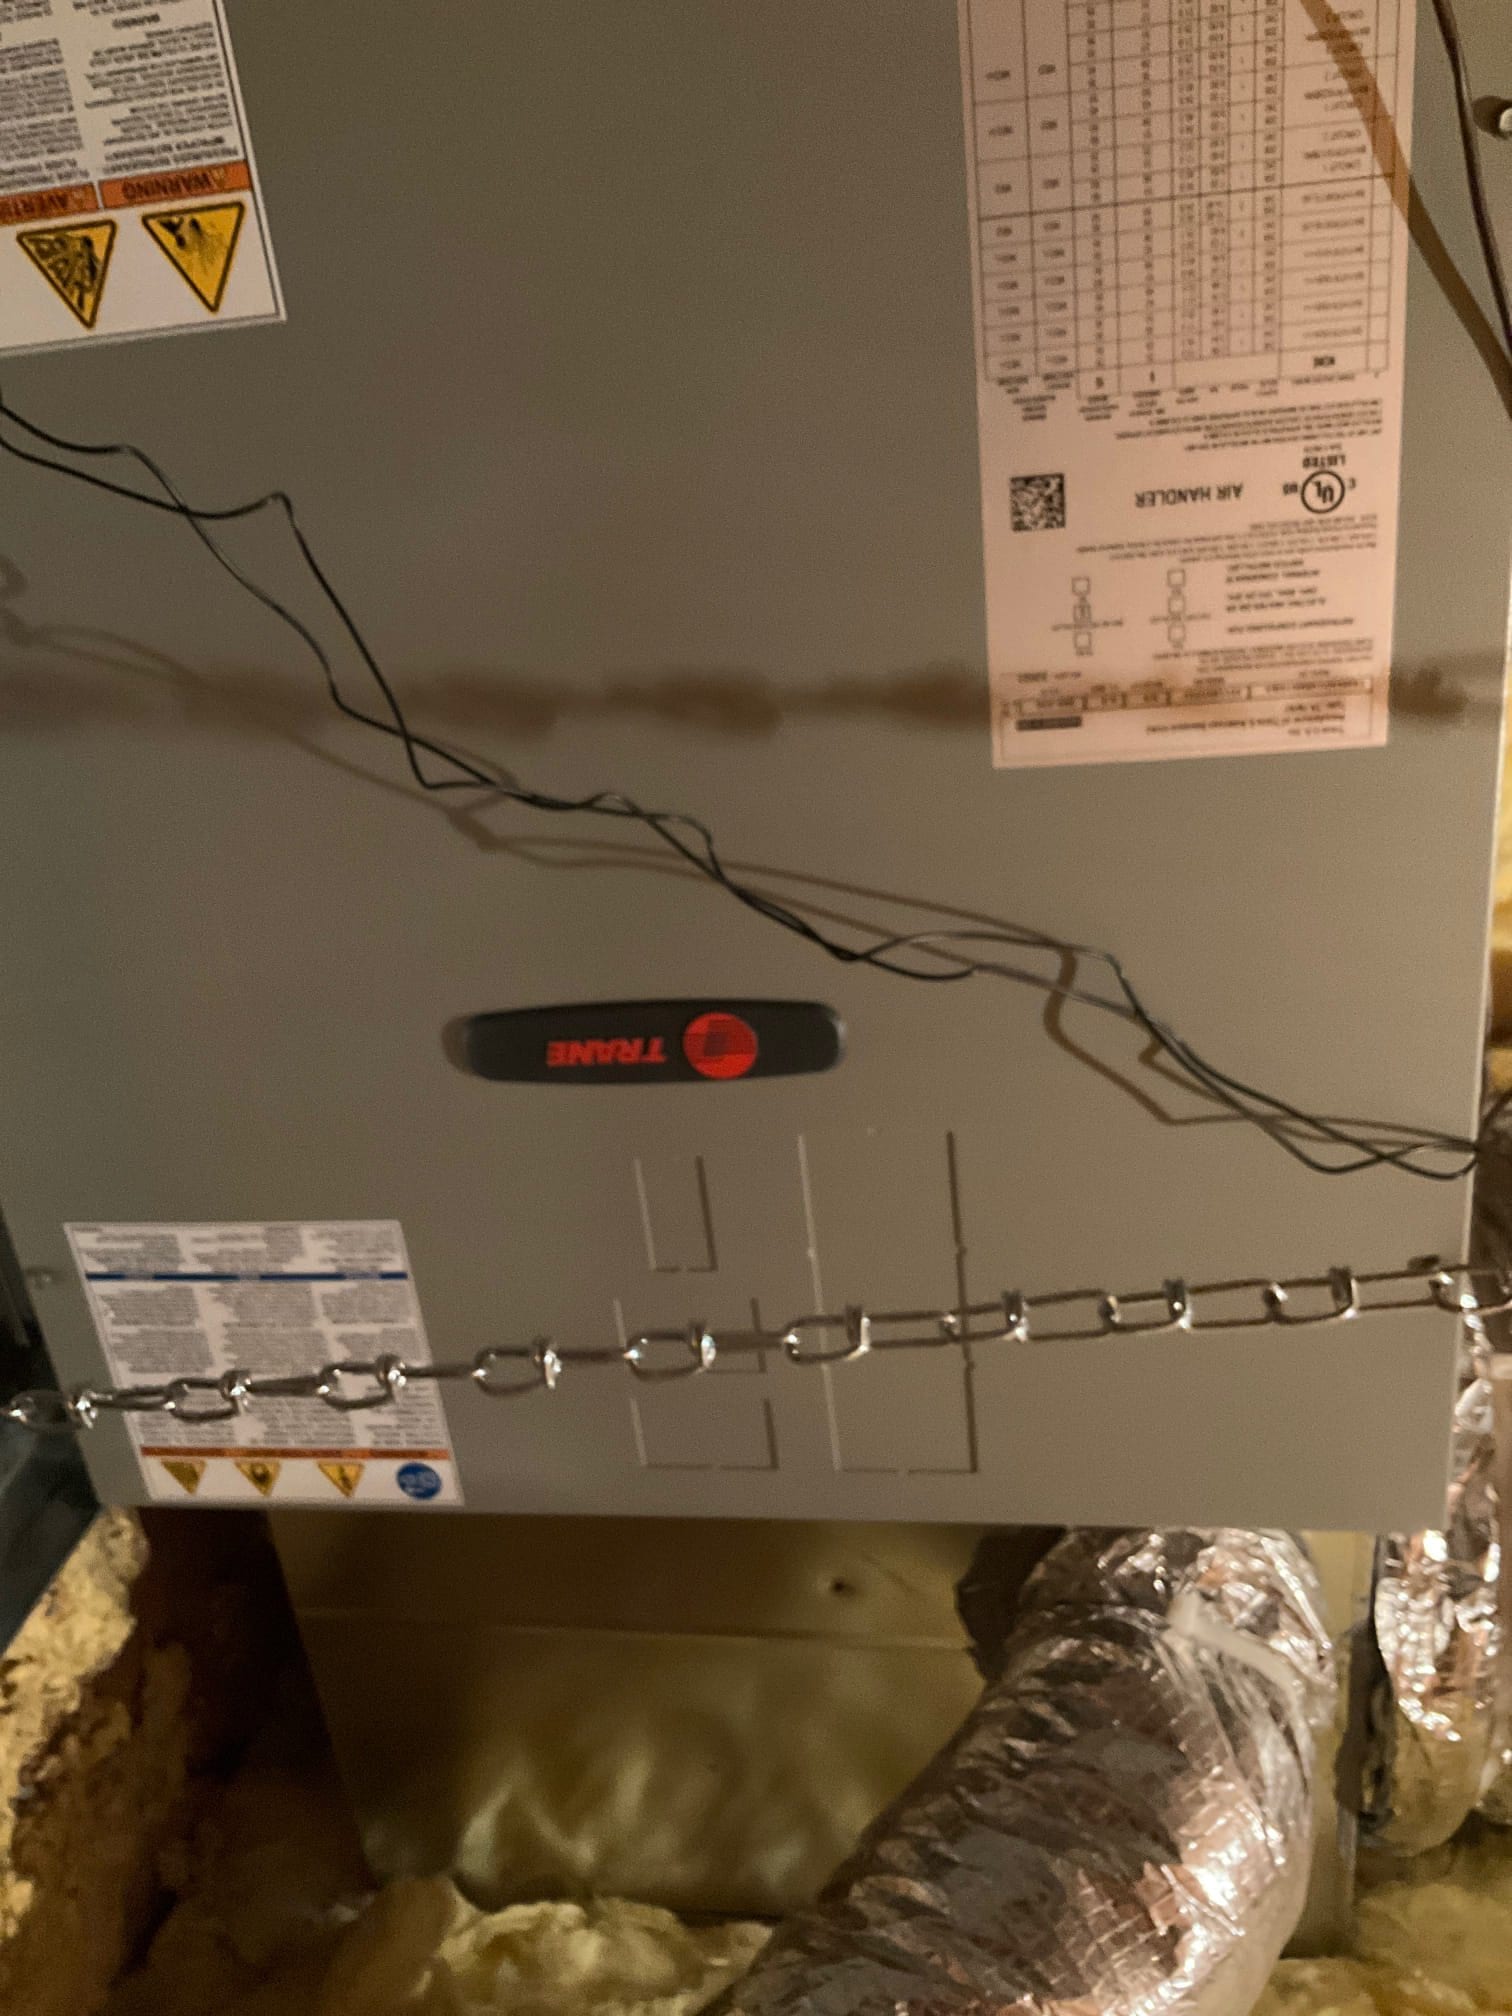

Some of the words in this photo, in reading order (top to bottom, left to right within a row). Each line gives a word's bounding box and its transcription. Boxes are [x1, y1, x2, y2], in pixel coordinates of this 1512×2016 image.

[123, 174, 211, 199] WARNING
[1303, 454, 1346, 469] LISTED
[1135, 488, 1210, 508] HANDLER
[1217, 484, 1243, 500] AIR
[547, 1038, 665, 1067] TRANE
